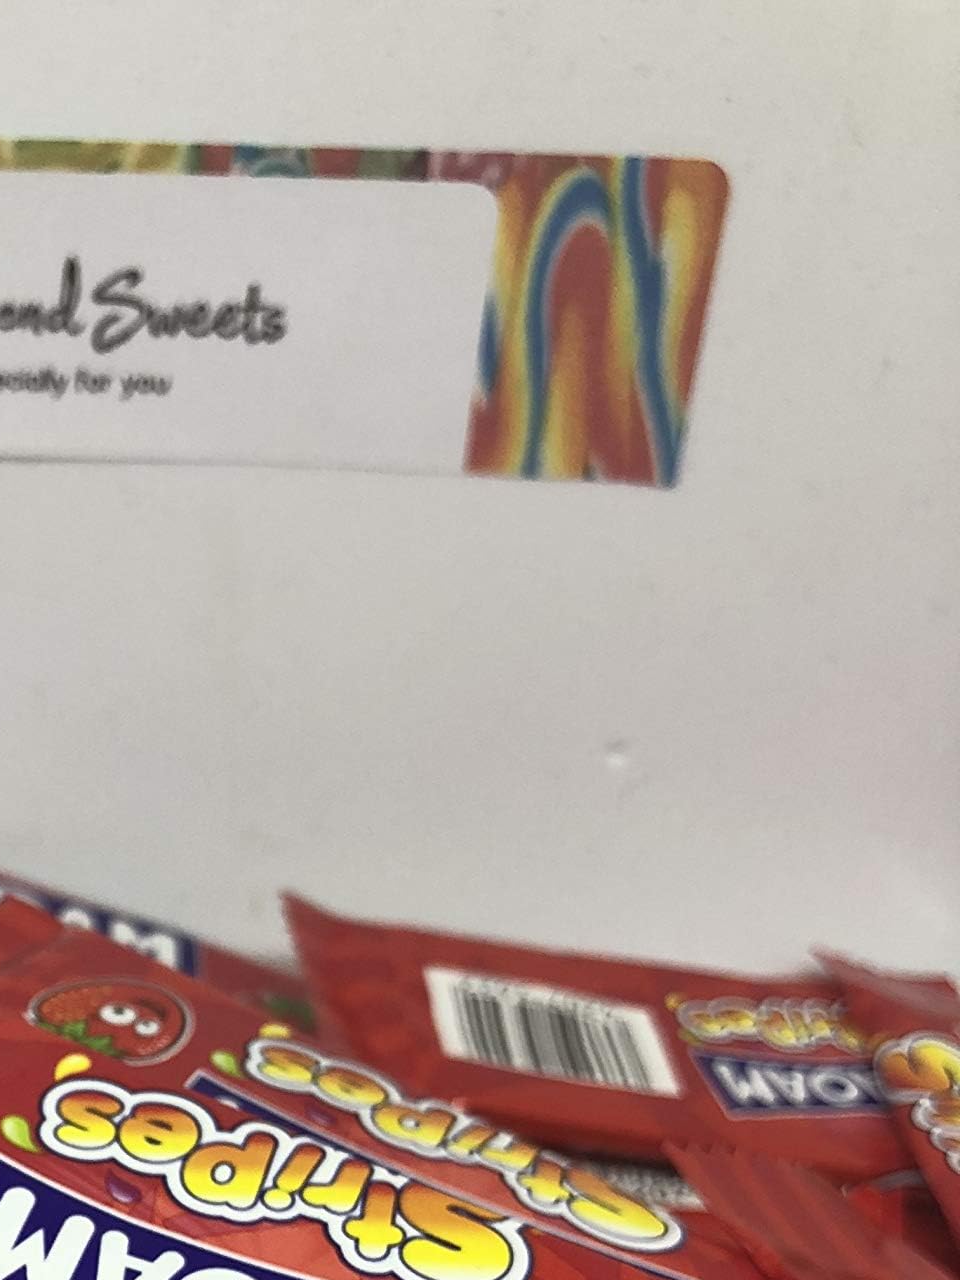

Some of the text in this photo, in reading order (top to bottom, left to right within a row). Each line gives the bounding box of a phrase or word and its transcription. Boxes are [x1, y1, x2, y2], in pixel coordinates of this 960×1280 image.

[90, 265, 287, 354] Sweets
[73, 365, 112, 395] for
[120, 371, 173, 400] you
[246, 1040, 682, 1250] Stripes
